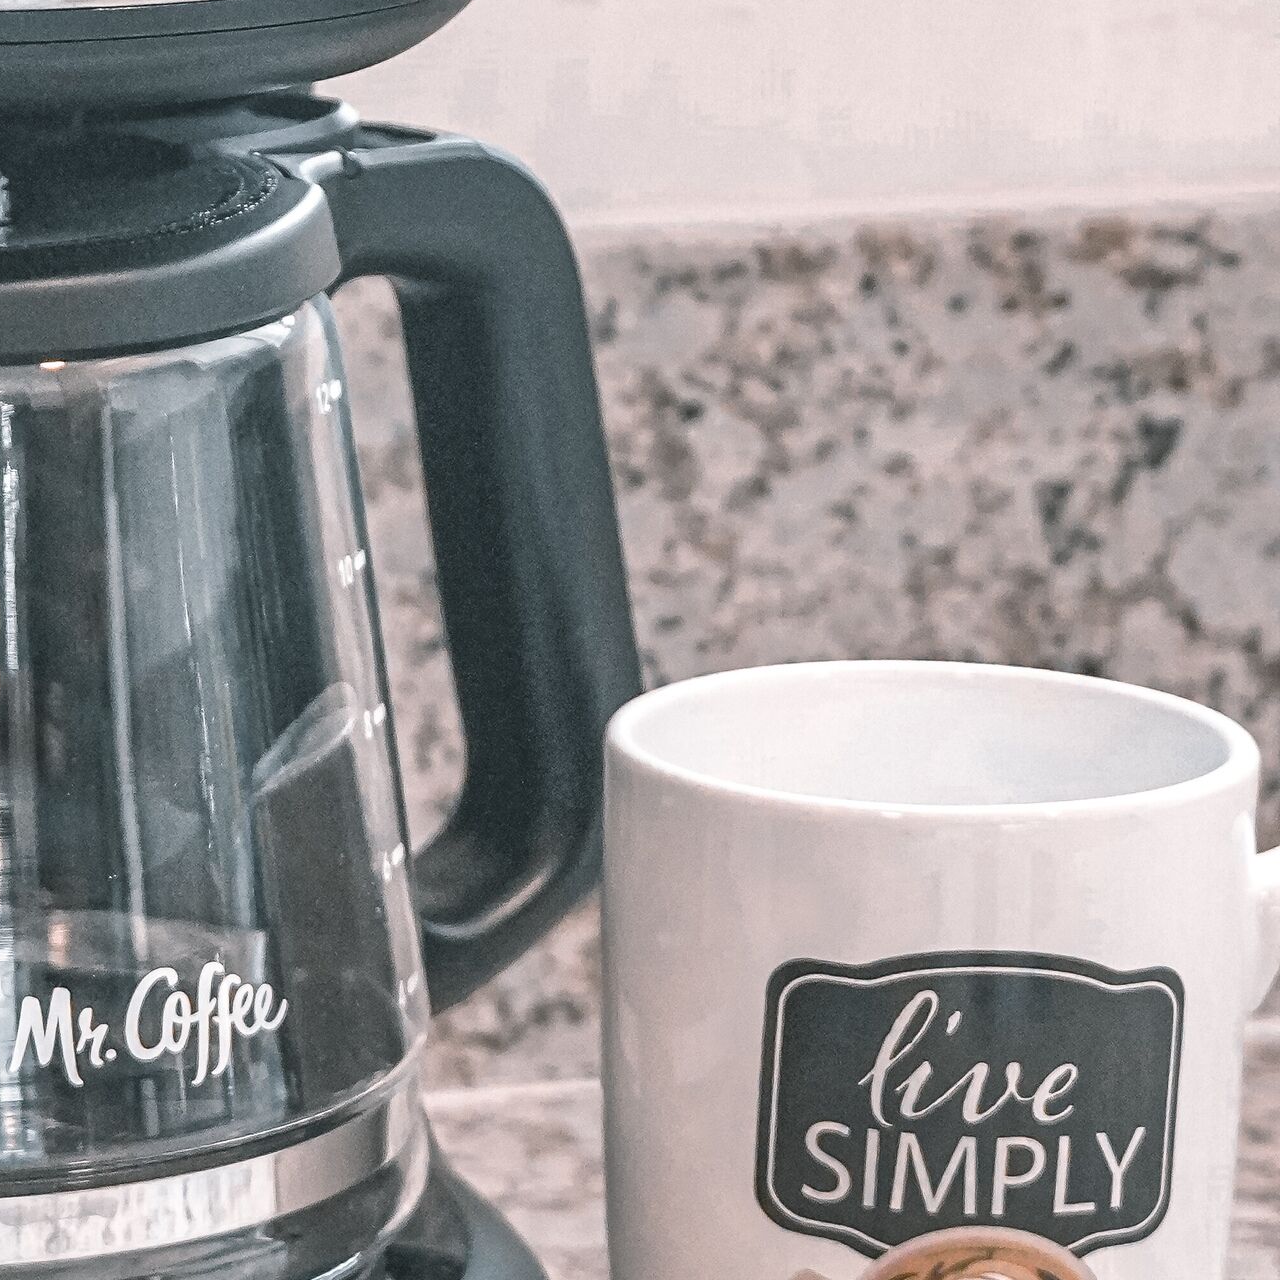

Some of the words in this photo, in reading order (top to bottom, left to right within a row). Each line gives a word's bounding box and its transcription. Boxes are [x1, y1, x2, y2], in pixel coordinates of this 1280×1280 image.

[8, 986, 117, 1088] Mr.
[124, 960, 289, 1087] Coffee
[858, 989, 1079, 1127] live
[801, 1120, 1147, 1219] SIMPLY
